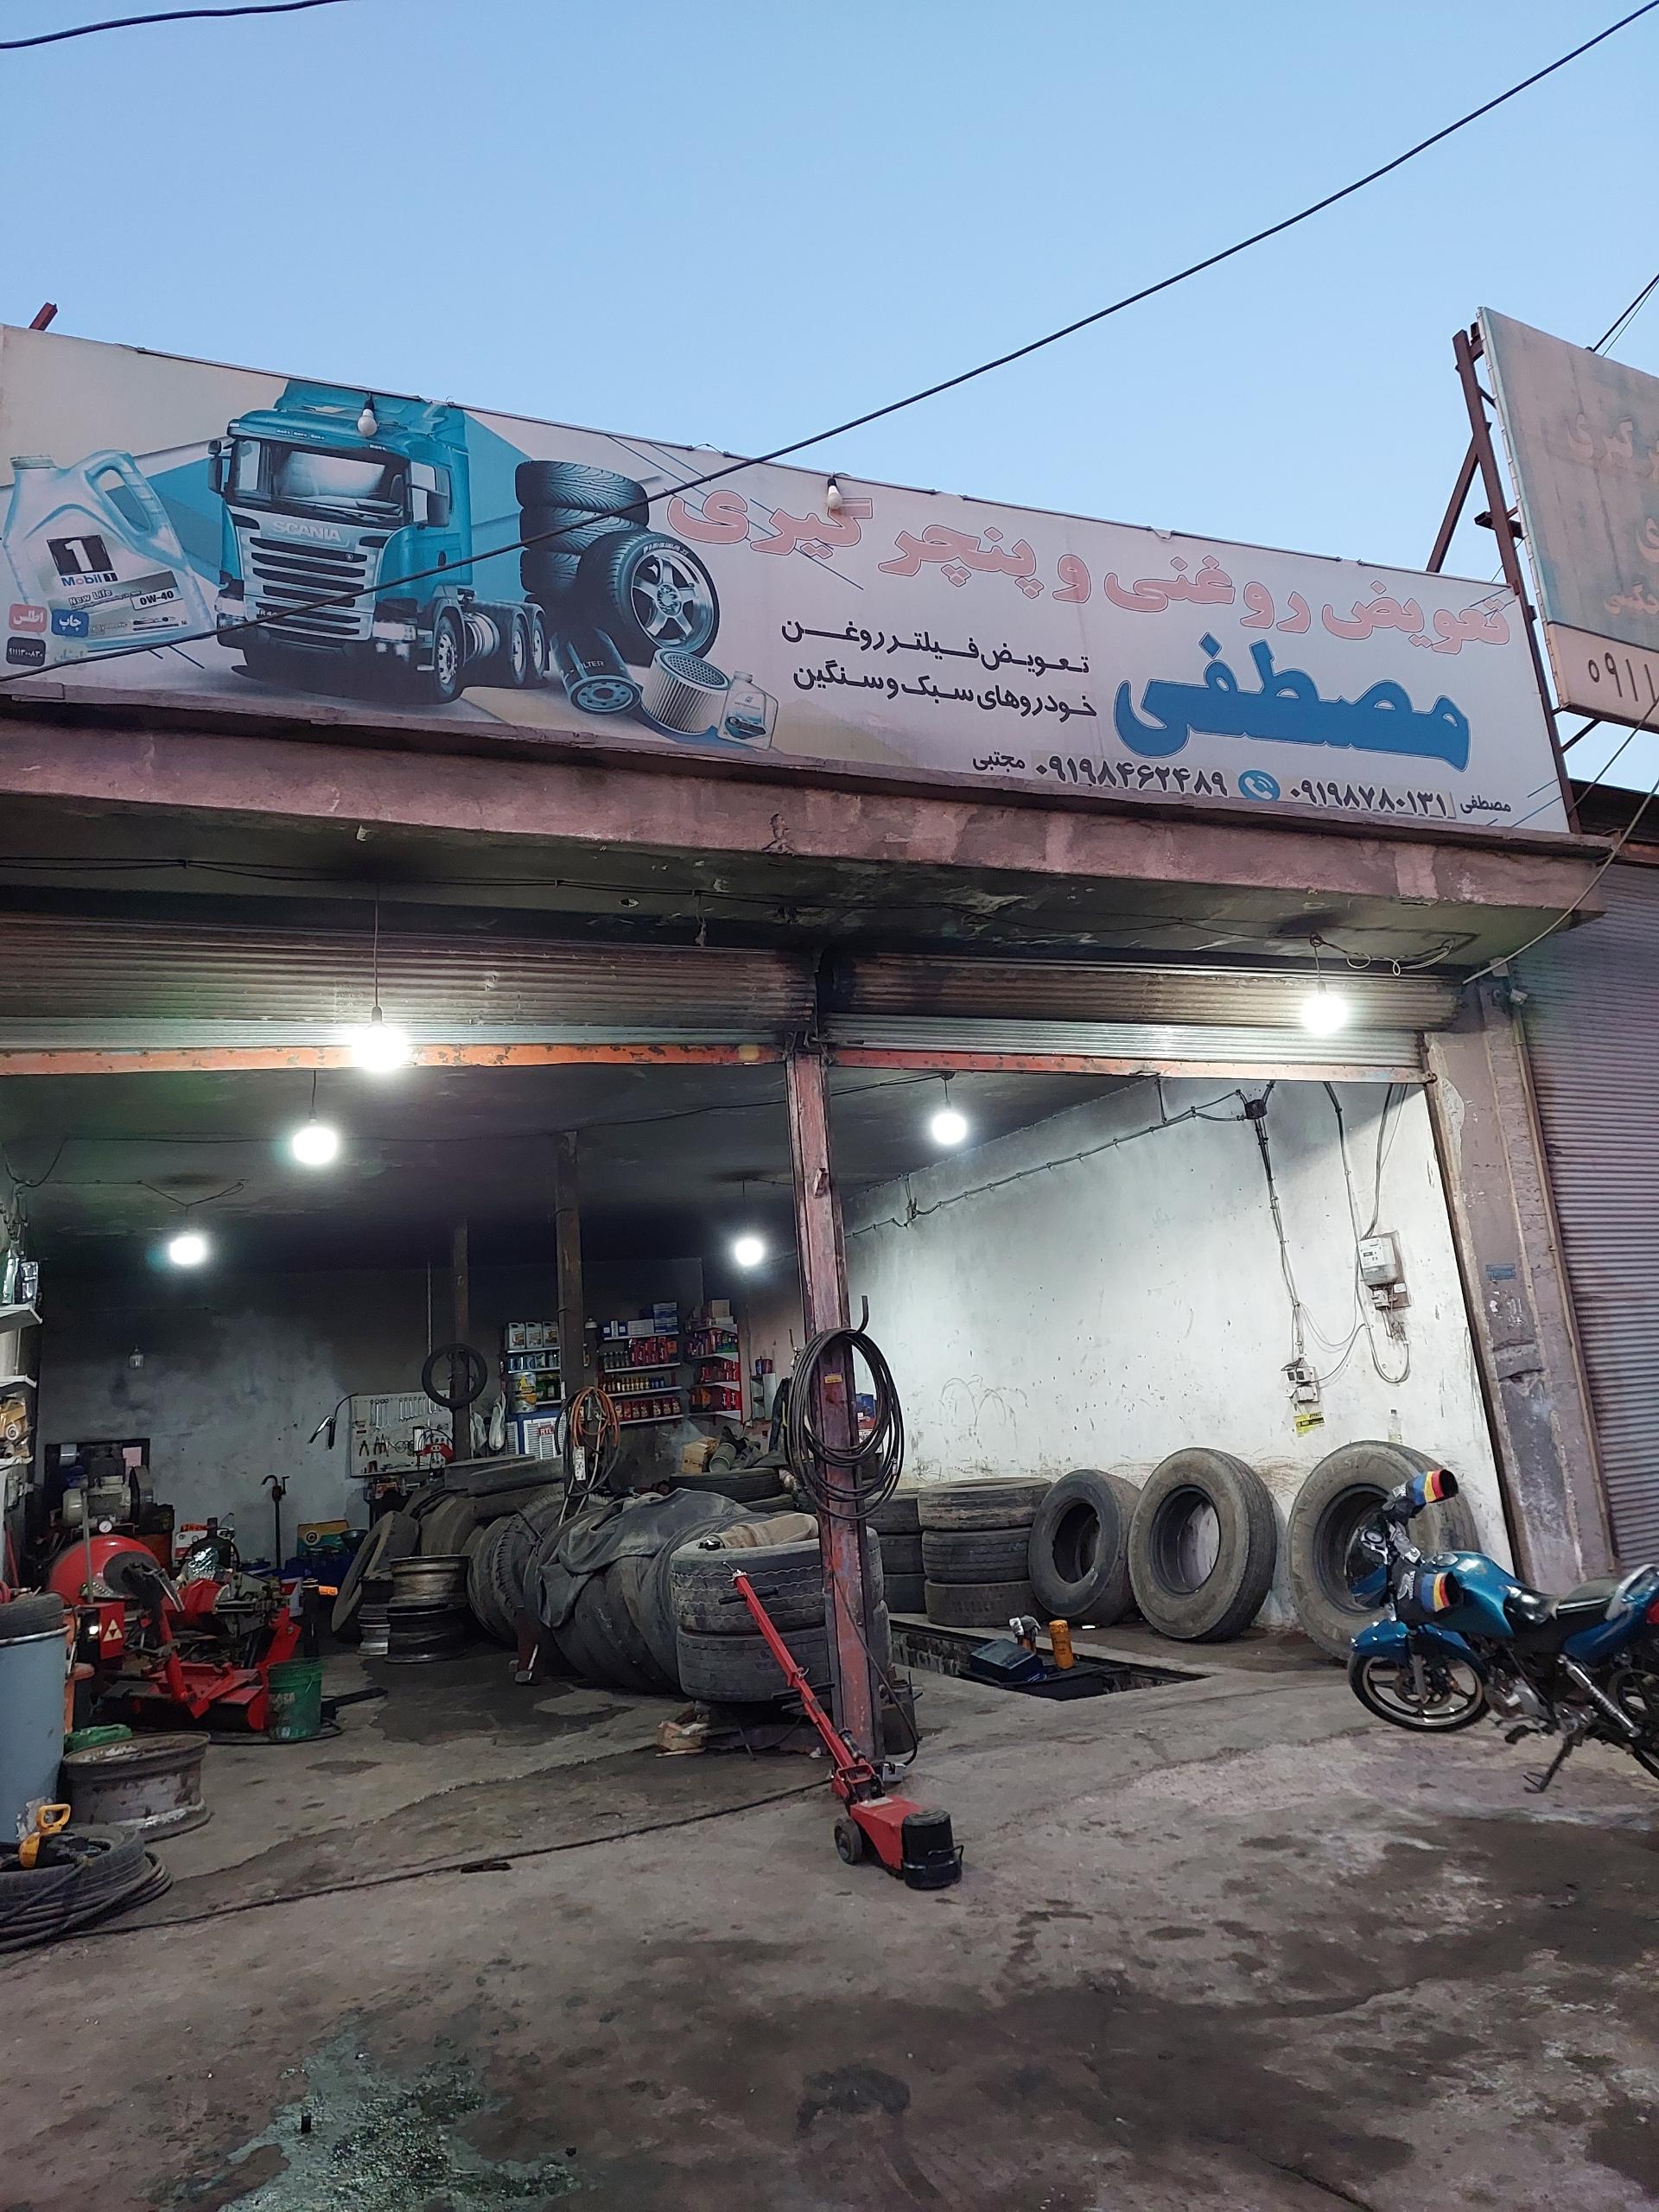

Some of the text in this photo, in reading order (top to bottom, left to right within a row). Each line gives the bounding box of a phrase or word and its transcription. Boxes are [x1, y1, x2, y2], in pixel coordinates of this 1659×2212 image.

[272, 521, 341, 543] SCANIA
[65, 539, 93, 571] 1
[61, 573, 118, 587] Mobil 1
[667, 490, 1510, 654] تعویض روغنی و پنچر گیری
[69, 594, 91, 607] New
[92, 588, 113, 602] Life
[139, 590, 175, 606] 0W-40
[13, 608, 45, 626] اطلس
[59, 613, 82, 632] چاپ
[781, 616, 1090, 677] تعویض فیلتر روغن
[793, 659, 1097, 722] خودروهای سبک و سنگین
[1114, 632, 1471, 772] مصطفی
[972, 751, 1511, 817] مصطفی ۰۹۱۹۸۷۸۰۱۳۱ ۰۹۱۹۸۴۶۲۴۸۹ مجتبی
